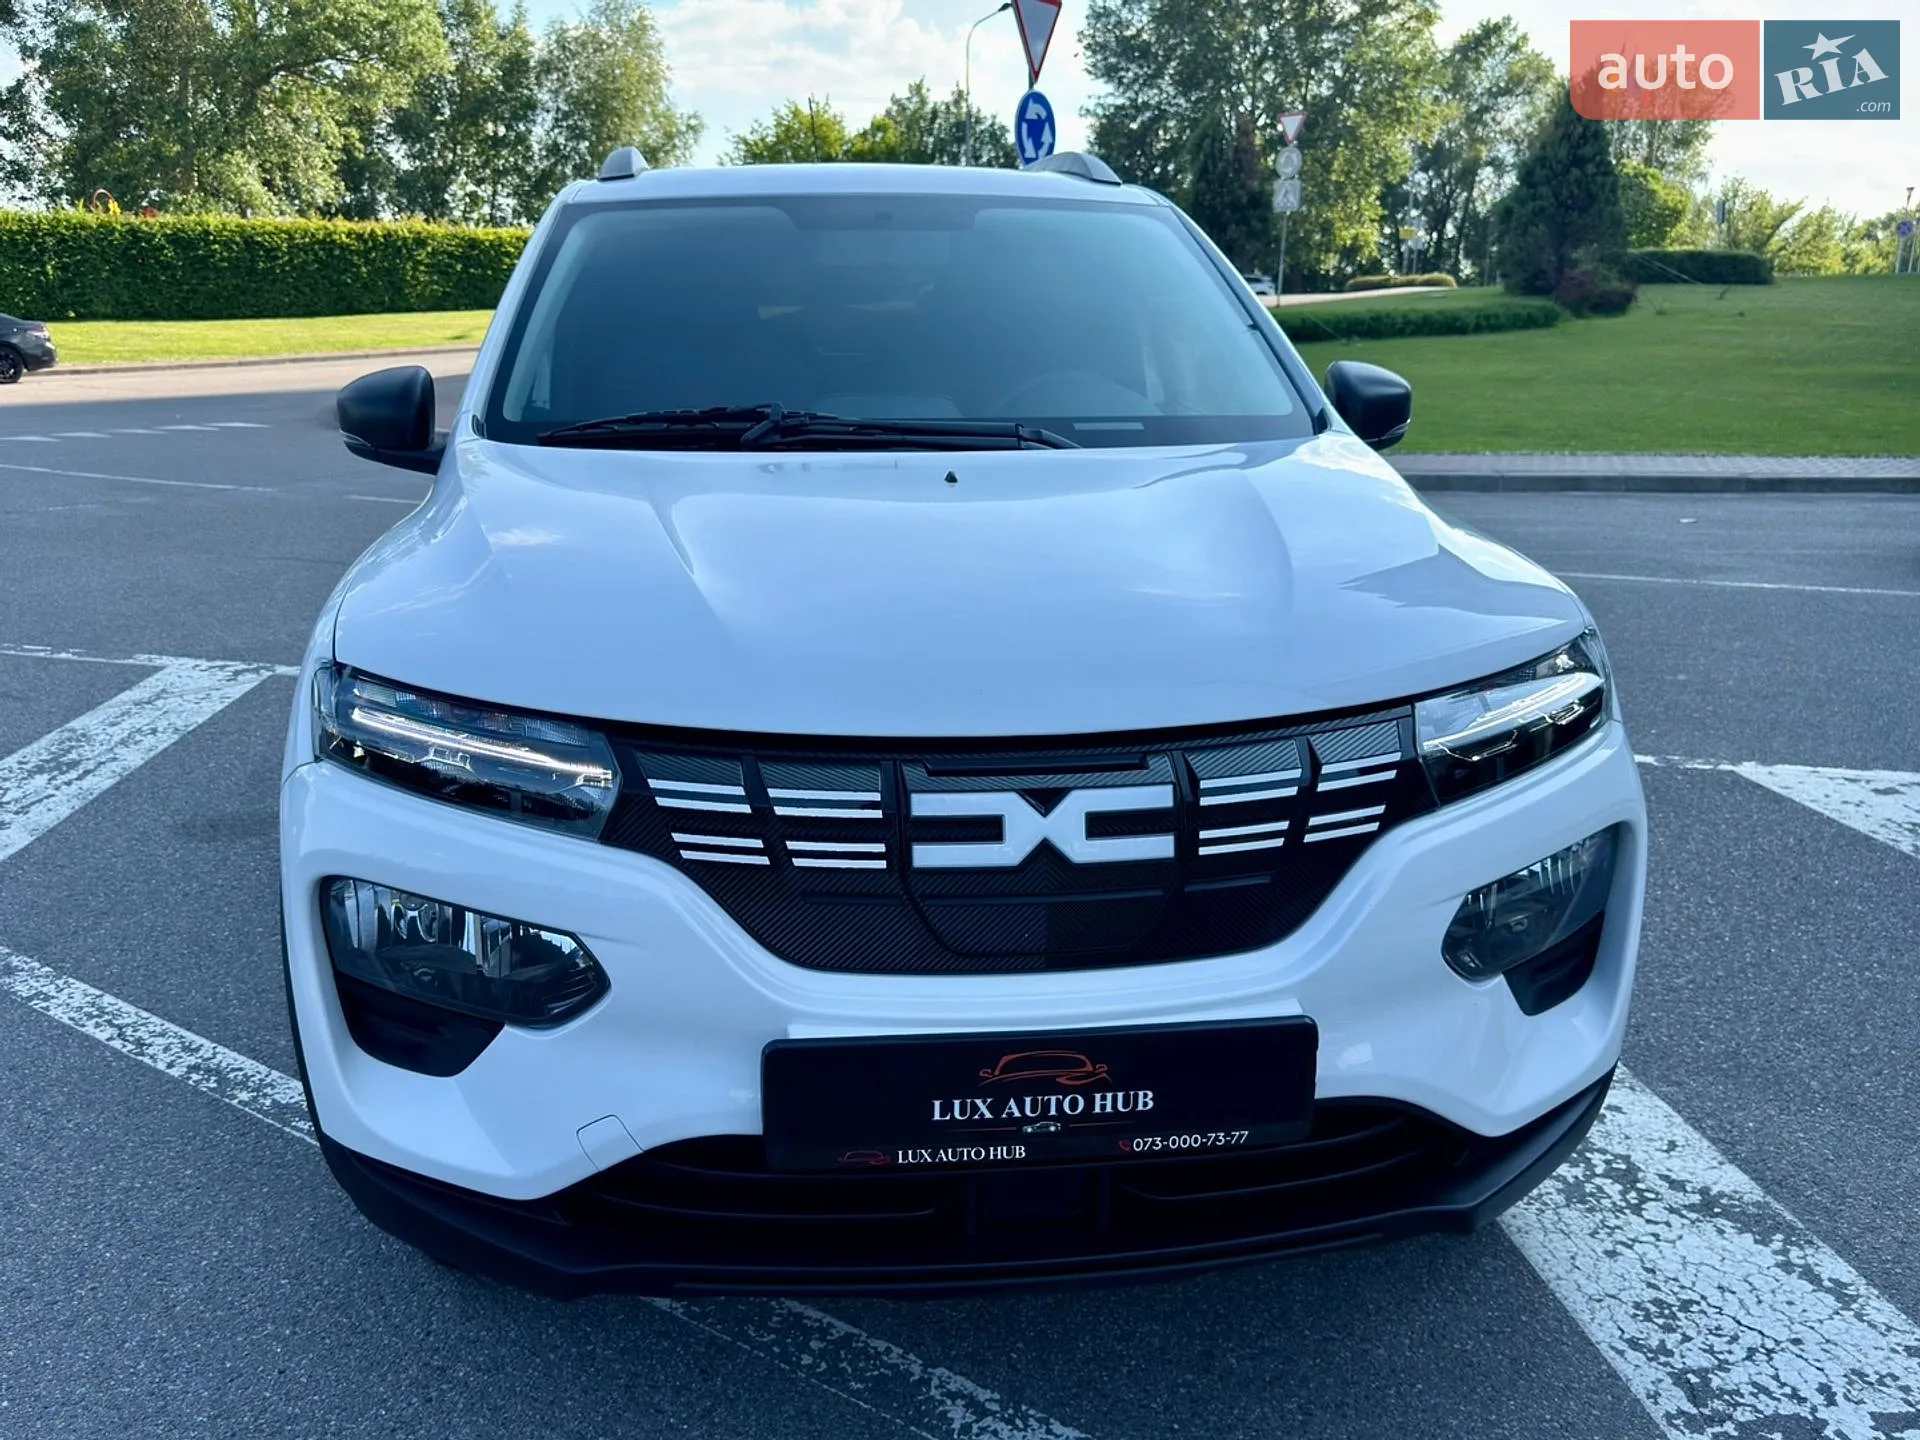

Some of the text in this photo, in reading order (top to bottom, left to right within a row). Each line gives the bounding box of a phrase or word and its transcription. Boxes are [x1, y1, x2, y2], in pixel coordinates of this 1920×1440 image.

[931, 1090, 1155, 1121] LUX AUTO HUB
[1132, 1130, 1250, 1152] 073-000-73-77
[897, 1145, 1027, 1164] LUX AUTO HUB
